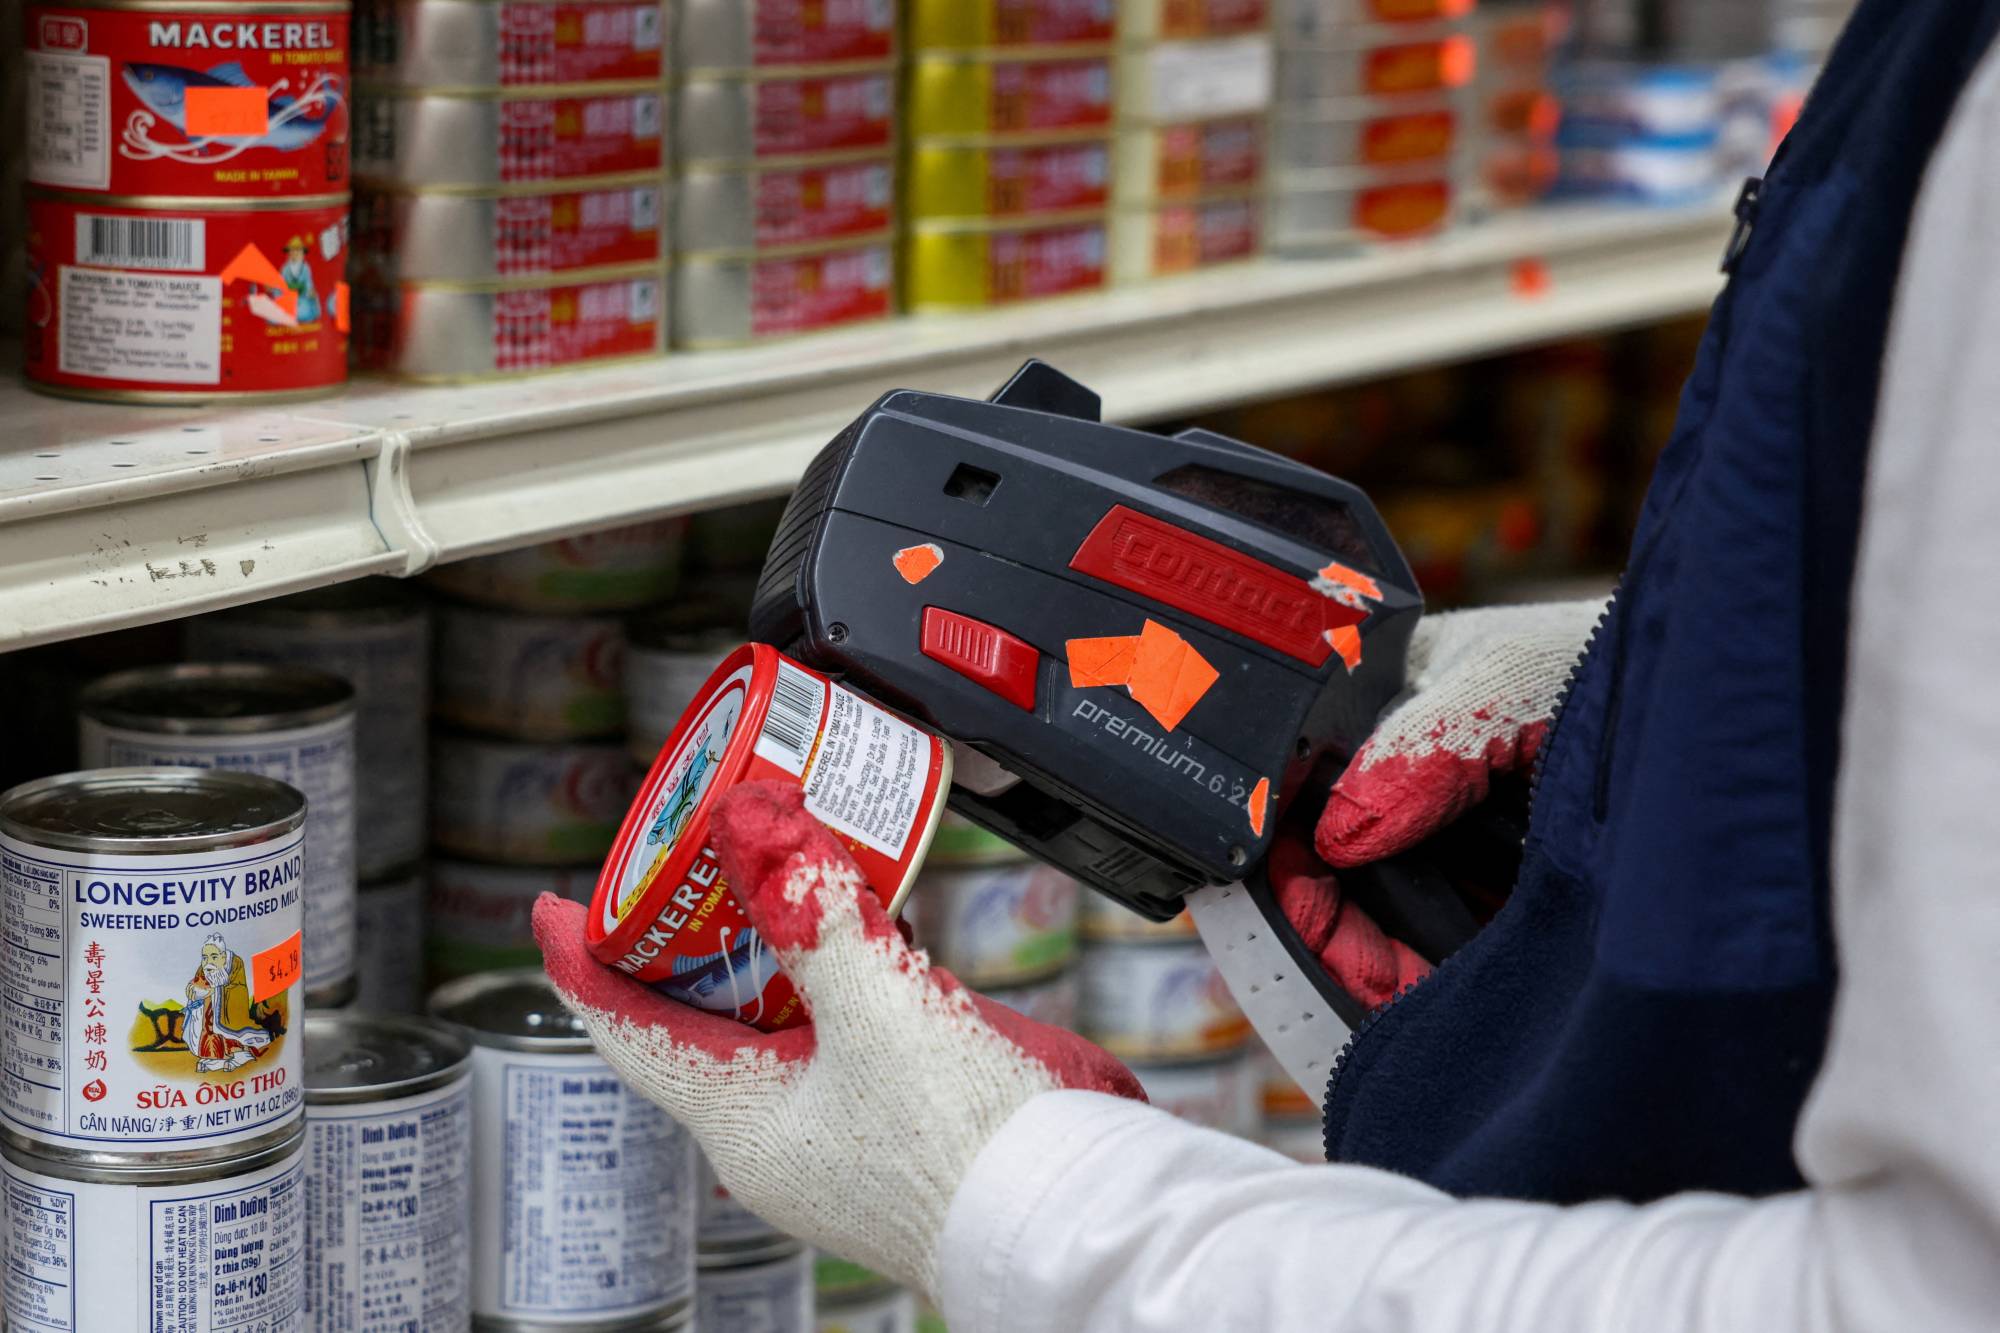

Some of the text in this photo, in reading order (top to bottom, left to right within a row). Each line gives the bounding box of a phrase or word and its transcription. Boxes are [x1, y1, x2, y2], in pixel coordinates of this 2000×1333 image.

[149, 22, 334, 49] MACKEREL
[215, 170, 245, 182] MADE
[127, 278, 166, 290] TOMATO
[170, 280, 200, 291] SAUCE
[829, 709, 842, 738] TOMATO
[825, 738, 835, 749] IN
[1071, 698, 1249, 811] premium 6.2
[807, 749, 833, 797] MACKEREL
[75, 855, 300, 905] LONGEVITY BRAND
[49, 885, 59, 895] 8%
[49, 898, 59, 910] 0%
[81, 887, 299, 929] SWEETENED CONDENSED MILK
[687, 876, 728, 932] IN TOMAT
[46, 927, 60, 940] 36%
[269, 949, 298, 982] $4.19
[50, 1018, 61, 1028] 8%
[51, 1031, 61, 1042] 0%
[48, 1059, 61, 1070] 36%
[136, 1067, 286, 1109] SỮA ÔNG THỌ
[80, 1113, 106, 1131] CÂN
[206, 1109, 231, 1127] NET
[234, 1106, 250, 1121] WT
[256, 1103, 266, 1118] 14
[268, 1098, 280, 1112] OZ
[21, 1204, 35, 1217] Carb.
[36, 1209, 48, 1223] 22g
[56, 1214, 66, 1224] 8%
[178, 1205, 186, 1223] CAN
[215, 1202, 236, 1224] Dinh
[29, 1220, 43, 1233] Fiber
[56, 1229, 67, 1239] 0%
[178, 1225, 186, 1233] IN
[43, 1239, 56, 1254] 22g
[178, 1236, 186, 1258] HEAT
[215, 1245, 238, 1261] Dùng
[52, 1255, 67, 1268] 36%
[178, 1260, 186, 1277] NOT
[215, 1265, 221, 1275] 2
[241, 1254, 261, 1271] (39g)
[154, 1284, 163, 1297] end
[178, 1280, 186, 1292] DO
[248, 1272, 267, 1299] 130
[156, 1299, 163, 1308] on
